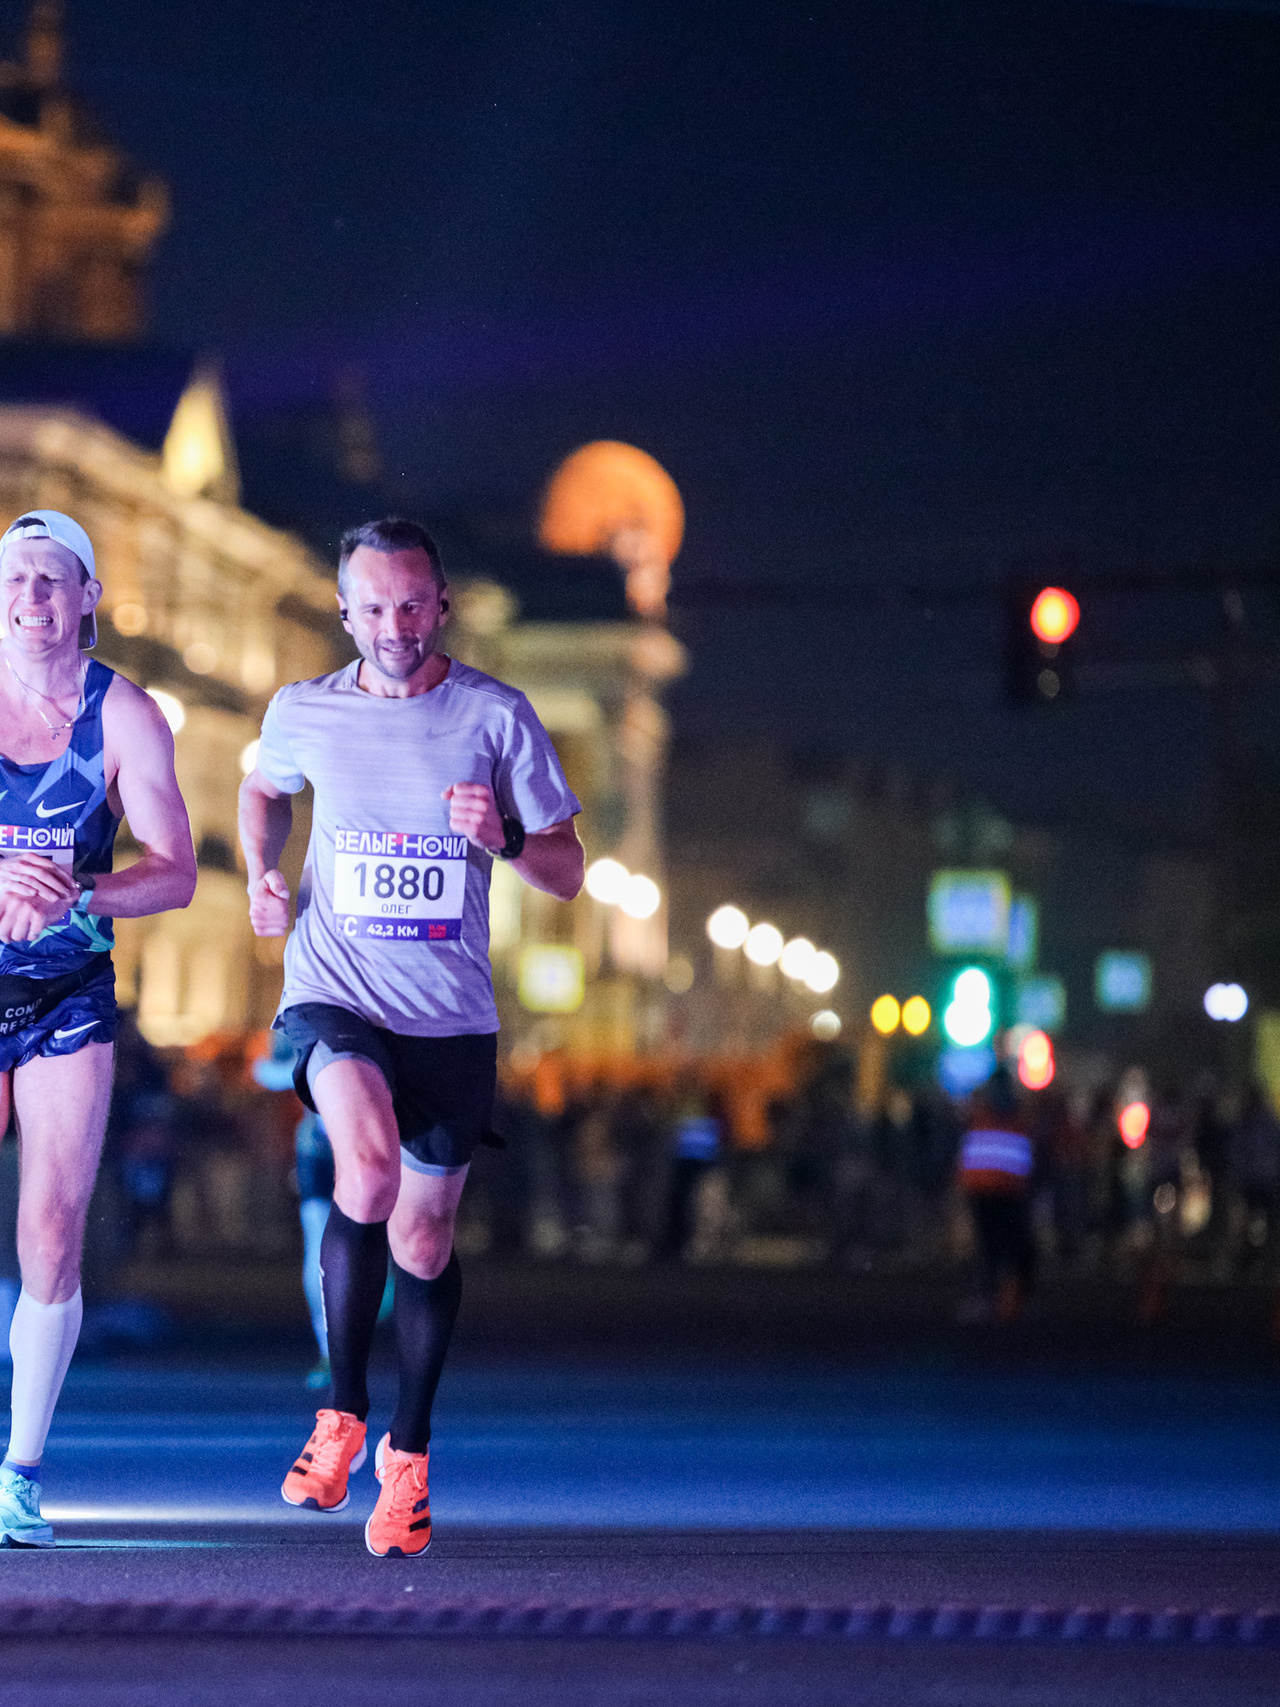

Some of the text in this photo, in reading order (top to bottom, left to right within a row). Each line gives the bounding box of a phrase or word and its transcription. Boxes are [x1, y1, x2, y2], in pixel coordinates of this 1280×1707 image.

[13, 826, 76, 848] НОЧИ
[335, 830, 468, 858] БЕЛЫЕ НОЧИ
[353, 862, 445, 901] 1880
[381, 903, 413, 915] ОЛЕГ
[366, 924, 394, 937] 42,2
